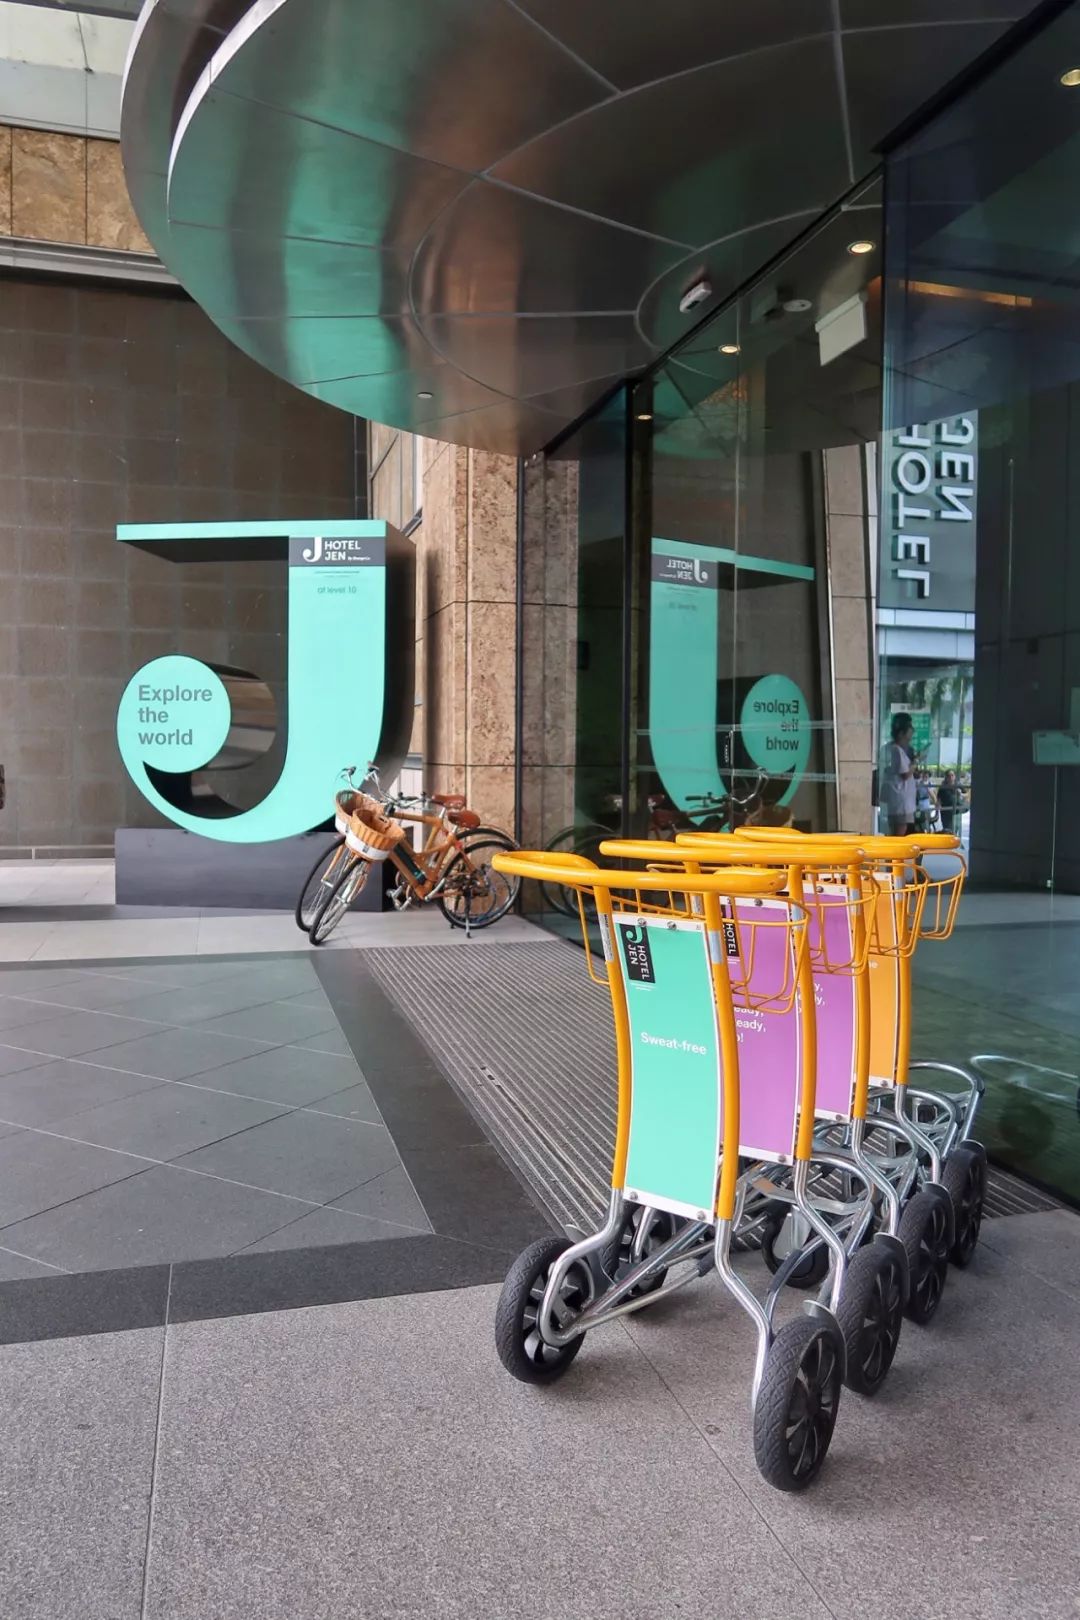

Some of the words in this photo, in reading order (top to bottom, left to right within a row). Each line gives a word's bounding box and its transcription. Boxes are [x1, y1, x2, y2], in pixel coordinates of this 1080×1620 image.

[324, 540, 361, 550] HOTEL
[324, 551, 346, 561] JEN
[138, 684, 213, 705] Explore
[137, 706, 169, 723] the
[138, 728, 193, 746] world
[725, 923, 737, 954] HOTEL
[627, 944, 639, 965] JEN
[636, 945, 650, 980] HOTEL
[736, 1019, 766, 1033] eady,
[640, 1031, 707, 1055] Sweat-free
